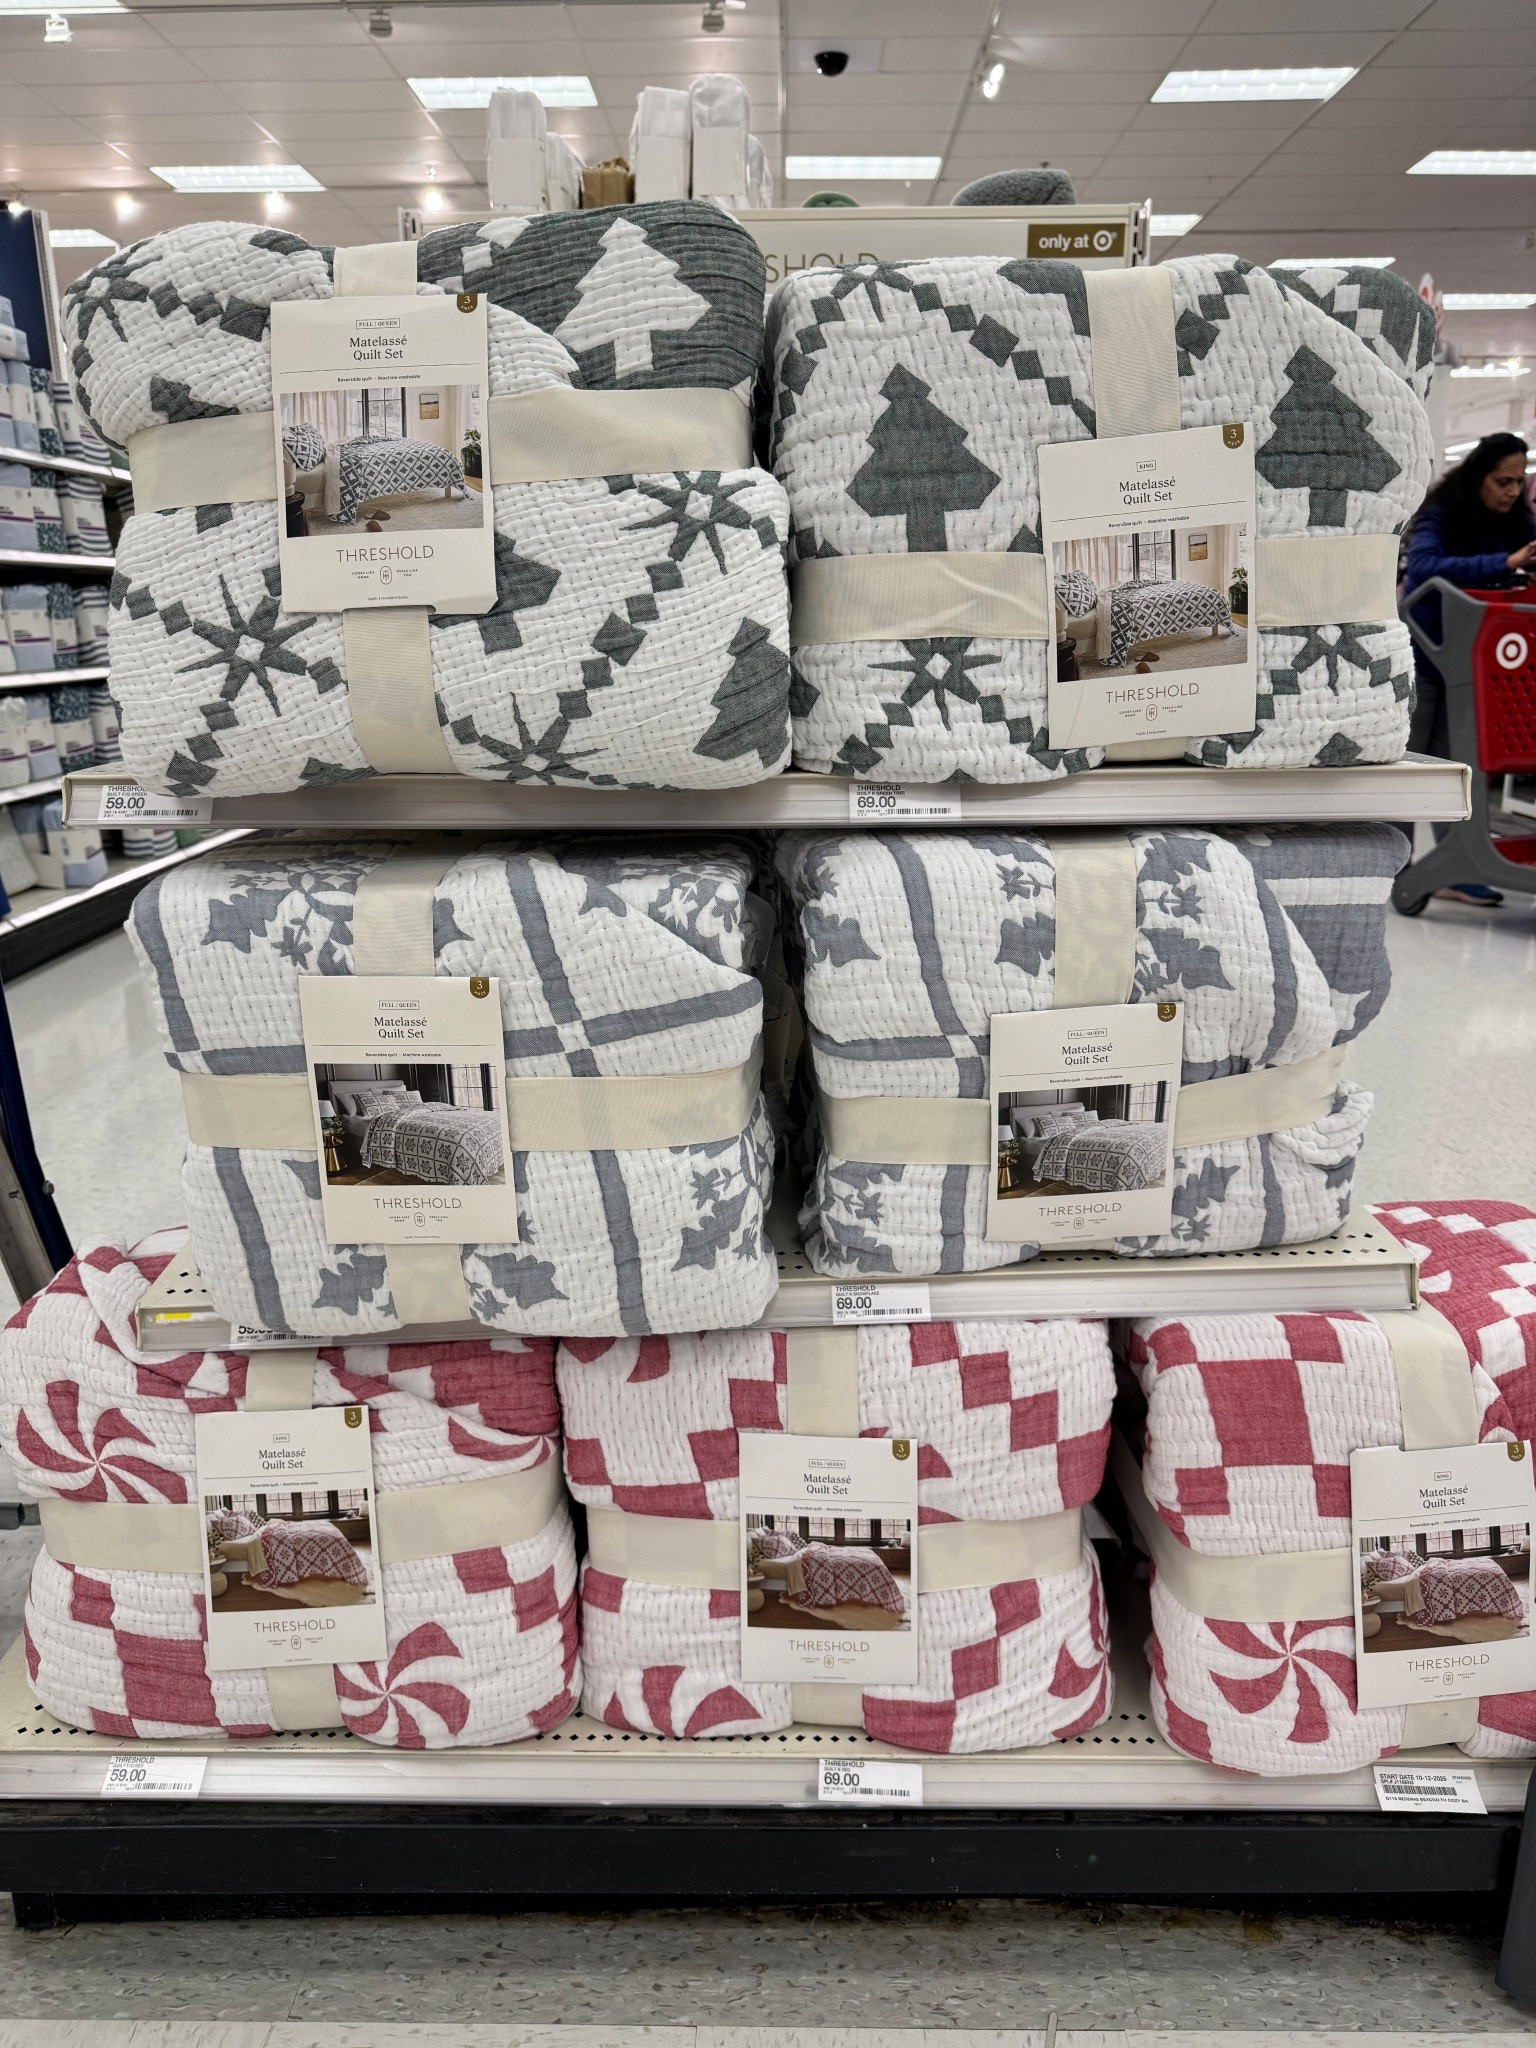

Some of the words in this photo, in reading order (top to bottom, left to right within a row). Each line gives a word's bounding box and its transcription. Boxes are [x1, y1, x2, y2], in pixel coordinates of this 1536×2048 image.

[1038, 235, 1071, 250] only
[1074, 235, 1089, 249] at
[464, 295, 470, 305] 3
[350, 335, 407, 347] Matelassé
[353, 349, 382, 361] Quilt
[385, 348, 404, 359] Set
[1230, 428, 1236, 439] 3
[1119, 476, 1175, 493] Matelassé
[1123, 492, 1151, 505] Quilt
[1154, 491, 1173, 501] Set
[336, 545, 434, 562] THRESHOLD
[1106, 682, 1200, 703] THRESHOLD
[106, 797, 145, 809] 59.00
[858, 796, 896, 808] 69.00
[477, 981, 482, 990] 3
[1164, 1005, 1170, 1014] 3
[374, 1017, 427, 1027] Matelassé
[378, 1029, 405, 1039] Quilt
[408, 1029, 424, 1038] Set
[1061, 1043, 1113, 1055] Matelassé
[1064, 1056, 1089, 1066] Quilt
[1092, 1055, 1109, 1064] Set
[373, 1198, 462, 1209] THRESHOLD
[1039, 1203, 1122, 1216] THRESHOLD
[836, 1297, 871, 1309] 69.00
[351, 1412, 356, 1420] 3
[259, 1448, 306, 1459] Matelassé
[899, 1444, 904, 1453] 3
[1513, 1444, 1519, 1453] 3
[262, 1460, 285, 1469] Quilt
[288, 1460, 303, 1468] Set
[803, 1474, 852, 1484] Matelassé
[806, 1485, 830, 1494] Quilt
[832, 1486, 848, 1495] Set
[1419, 1485, 1468, 1498] Matelassé
[1422, 1498, 1446, 1509] Quilt
[1449, 1497, 1465, 1506] Set
[254, 1619, 336, 1633] THRESHOLD
[789, 1640, 869, 1652] THRESHOLD
[1407, 1654, 1490, 1672] THRESHOLD
[110, 1769, 146, 1782] 59.00
[824, 1772, 859, 1786] 69.00
